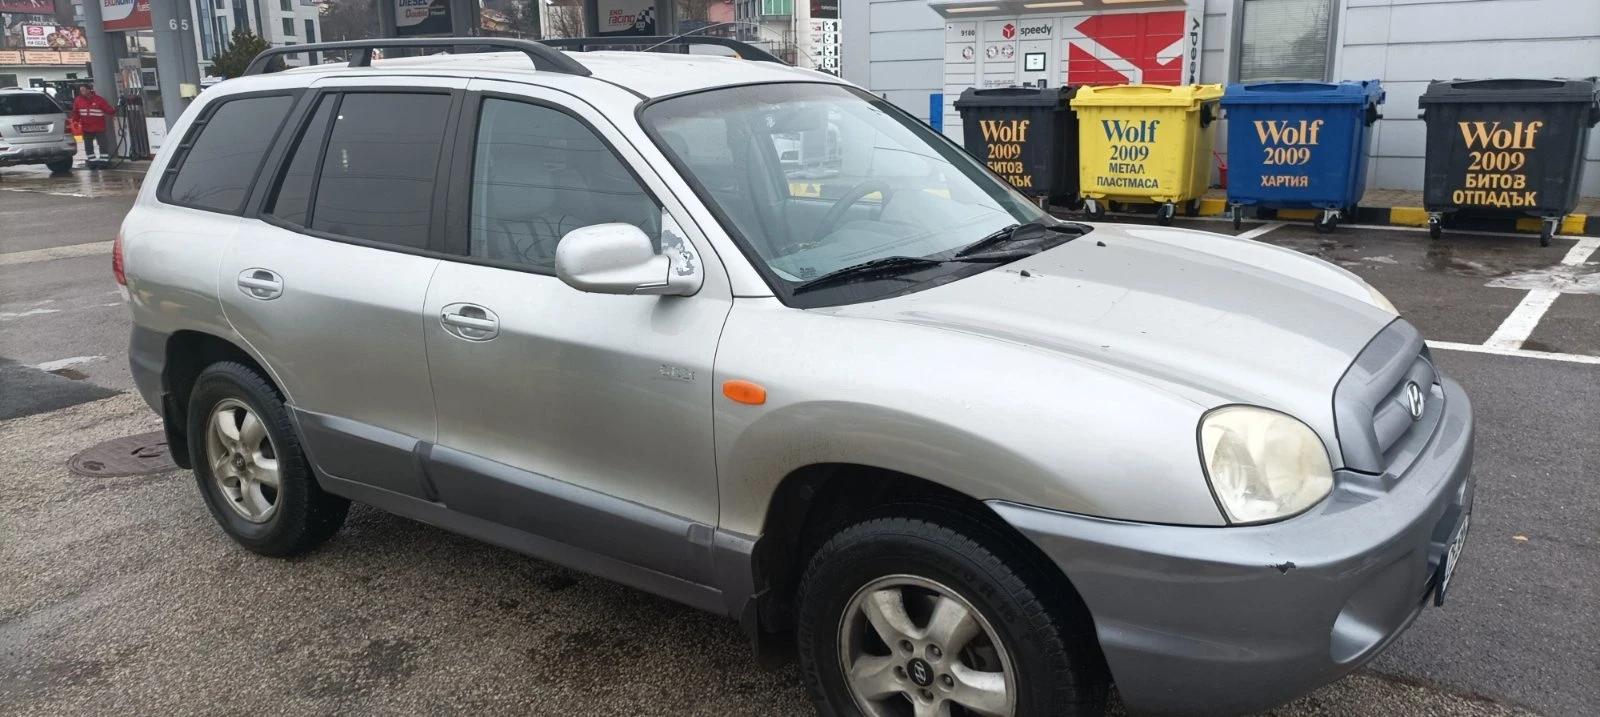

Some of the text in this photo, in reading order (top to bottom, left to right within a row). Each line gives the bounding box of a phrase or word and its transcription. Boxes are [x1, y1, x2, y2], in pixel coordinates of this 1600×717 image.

[169, 19, 189, 31] 6 5
[609, 15, 636, 25] racing
[1020, 24, 1052, 36] speedy
[979, 120, 1030, 142] Wolf
[1101, 119, 1160, 143] Wolf
[1253, 119, 1325, 146] Wolf
[1457, 120, 1543, 150] Wolf
[987, 144, 1021, 160] 2009
[1110, 145, 1149, 161] 2009
[1263, 147, 1311, 166] 2009
[1109, 163, 1145, 174] МЕТАЛ
[1467, 151, 1526, 172] 2009
[1097, 176, 1159, 189] ПЛАСТМАСА
[1260, 175, 1308, 187] ХАРТИЯ
[1465, 173, 1526, 189] БИТОВ
[1452, 190, 1537, 208] ОТПАДЪК
